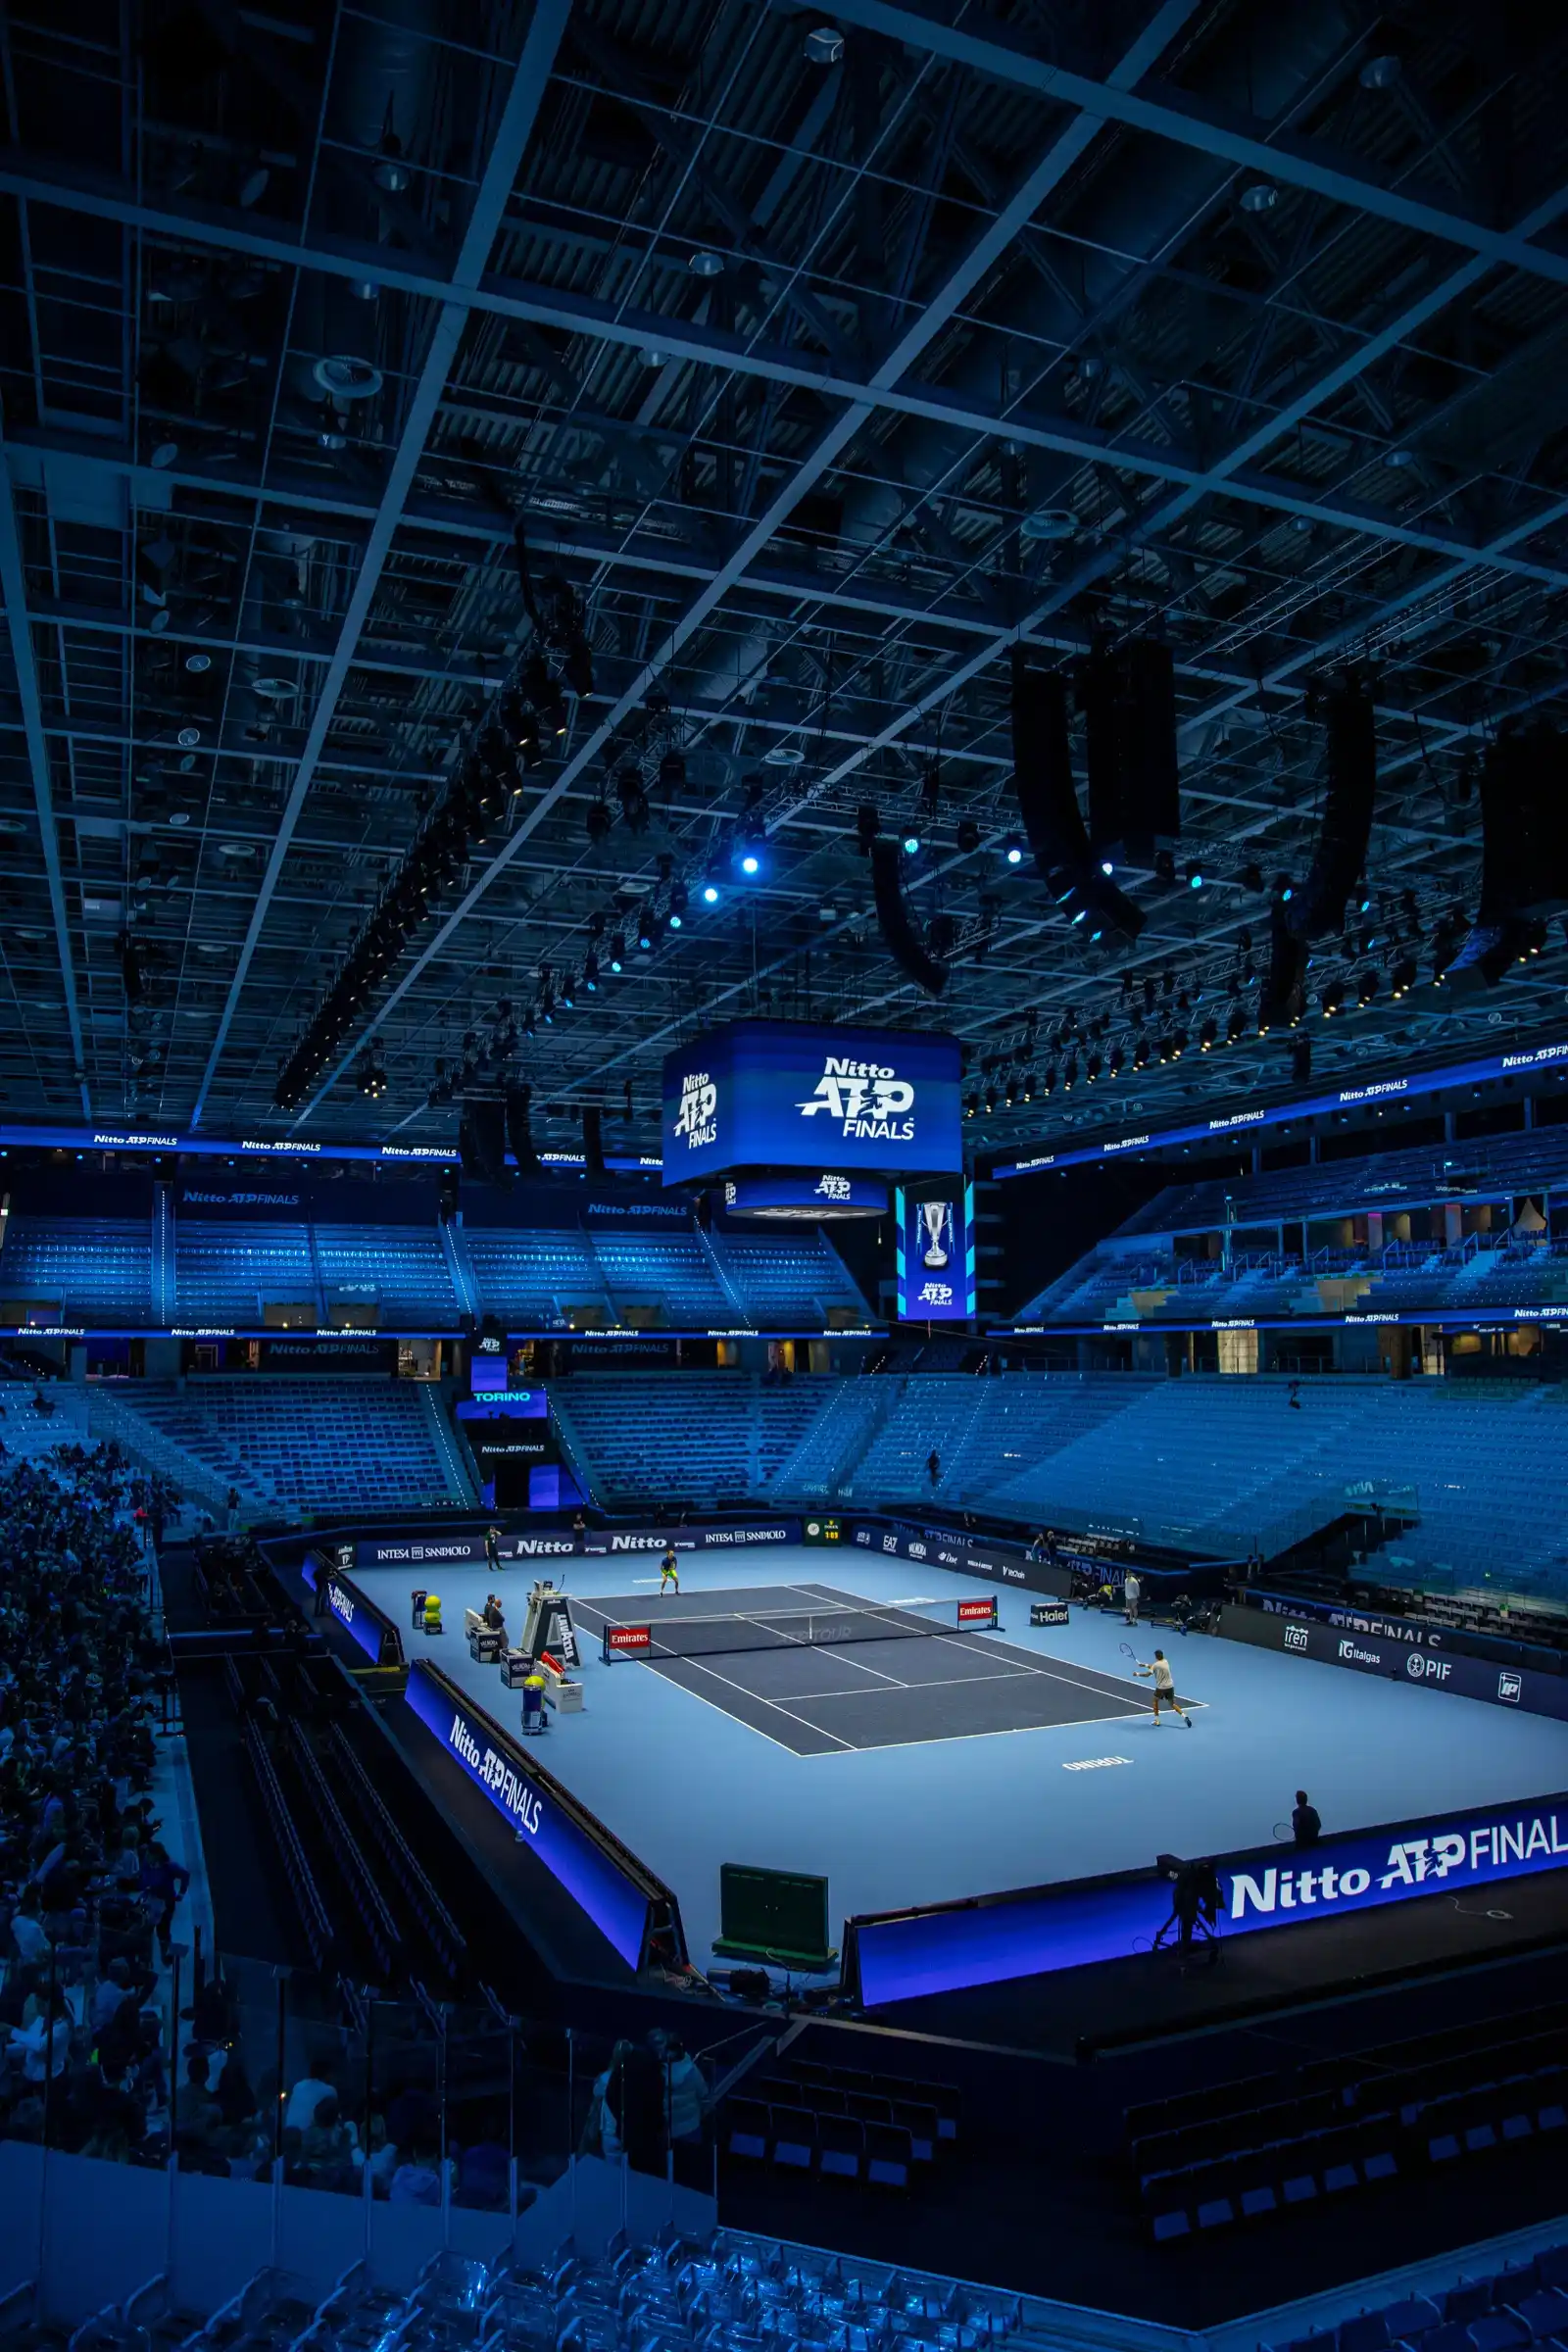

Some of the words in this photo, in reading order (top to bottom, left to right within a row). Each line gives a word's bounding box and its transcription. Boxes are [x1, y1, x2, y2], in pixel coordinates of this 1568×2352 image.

[824, 1056, 896, 1079] Nitto
[1502, 1055, 1534, 1067] Nitto
[683, 1072, 710, 1095] Nitto
[795, 1076, 914, 1119] ATP
[1340, 1092, 1363, 1102] Nitto
[673, 1083, 717, 1137] ATP
[843, 1120, 914, 1141] FINALS
[1209, 1120, 1229, 1129] Nitto
[94, 1135, 124, 1144] Nitto
[689, 1123, 717, 1150] FINALS
[242, 1141, 271, 1150] Nitto
[382, 1147, 410, 1155] Nitto
[1103, 1142, 1120, 1152] Nitto
[183, 1189, 225, 1203] Nitto
[588, 1203, 626, 1215] Nitto
[1514, 1308, 1540, 1318] Nitto
[18, 1327, 43, 1336] Nitto
[270, 1342, 310, 1354] Nitto
[473, 1393, 530, 1402] TORINO
[481, 1446, 506, 1454] Nitto
[612, 1536, 668, 1550] Nitto
[706, 1533, 734, 1544] INTESA
[883, 1535, 898, 1548] EA7
[376, 1547, 412, 1560] INTESA
[516, 1540, 574, 1555] Nitto
[959, 1605, 991, 1616] Emirates
[1040, 1610, 1068, 1623] Haier
[557, 1614, 574, 1658] LAVAZZA
[612, 1633, 649, 1644] Emirates
[1284, 1631, 1307, 1645] iren
[1425, 1659, 1452, 1681] PIF
[450, 1714, 480, 1769] Nitto
[478, 1747, 505, 1791] ATP
[500, 1768, 543, 1835] FINALS
[1229, 1866, 1370, 1919] Nitto
[1374, 1834, 1466, 1889] ATP
